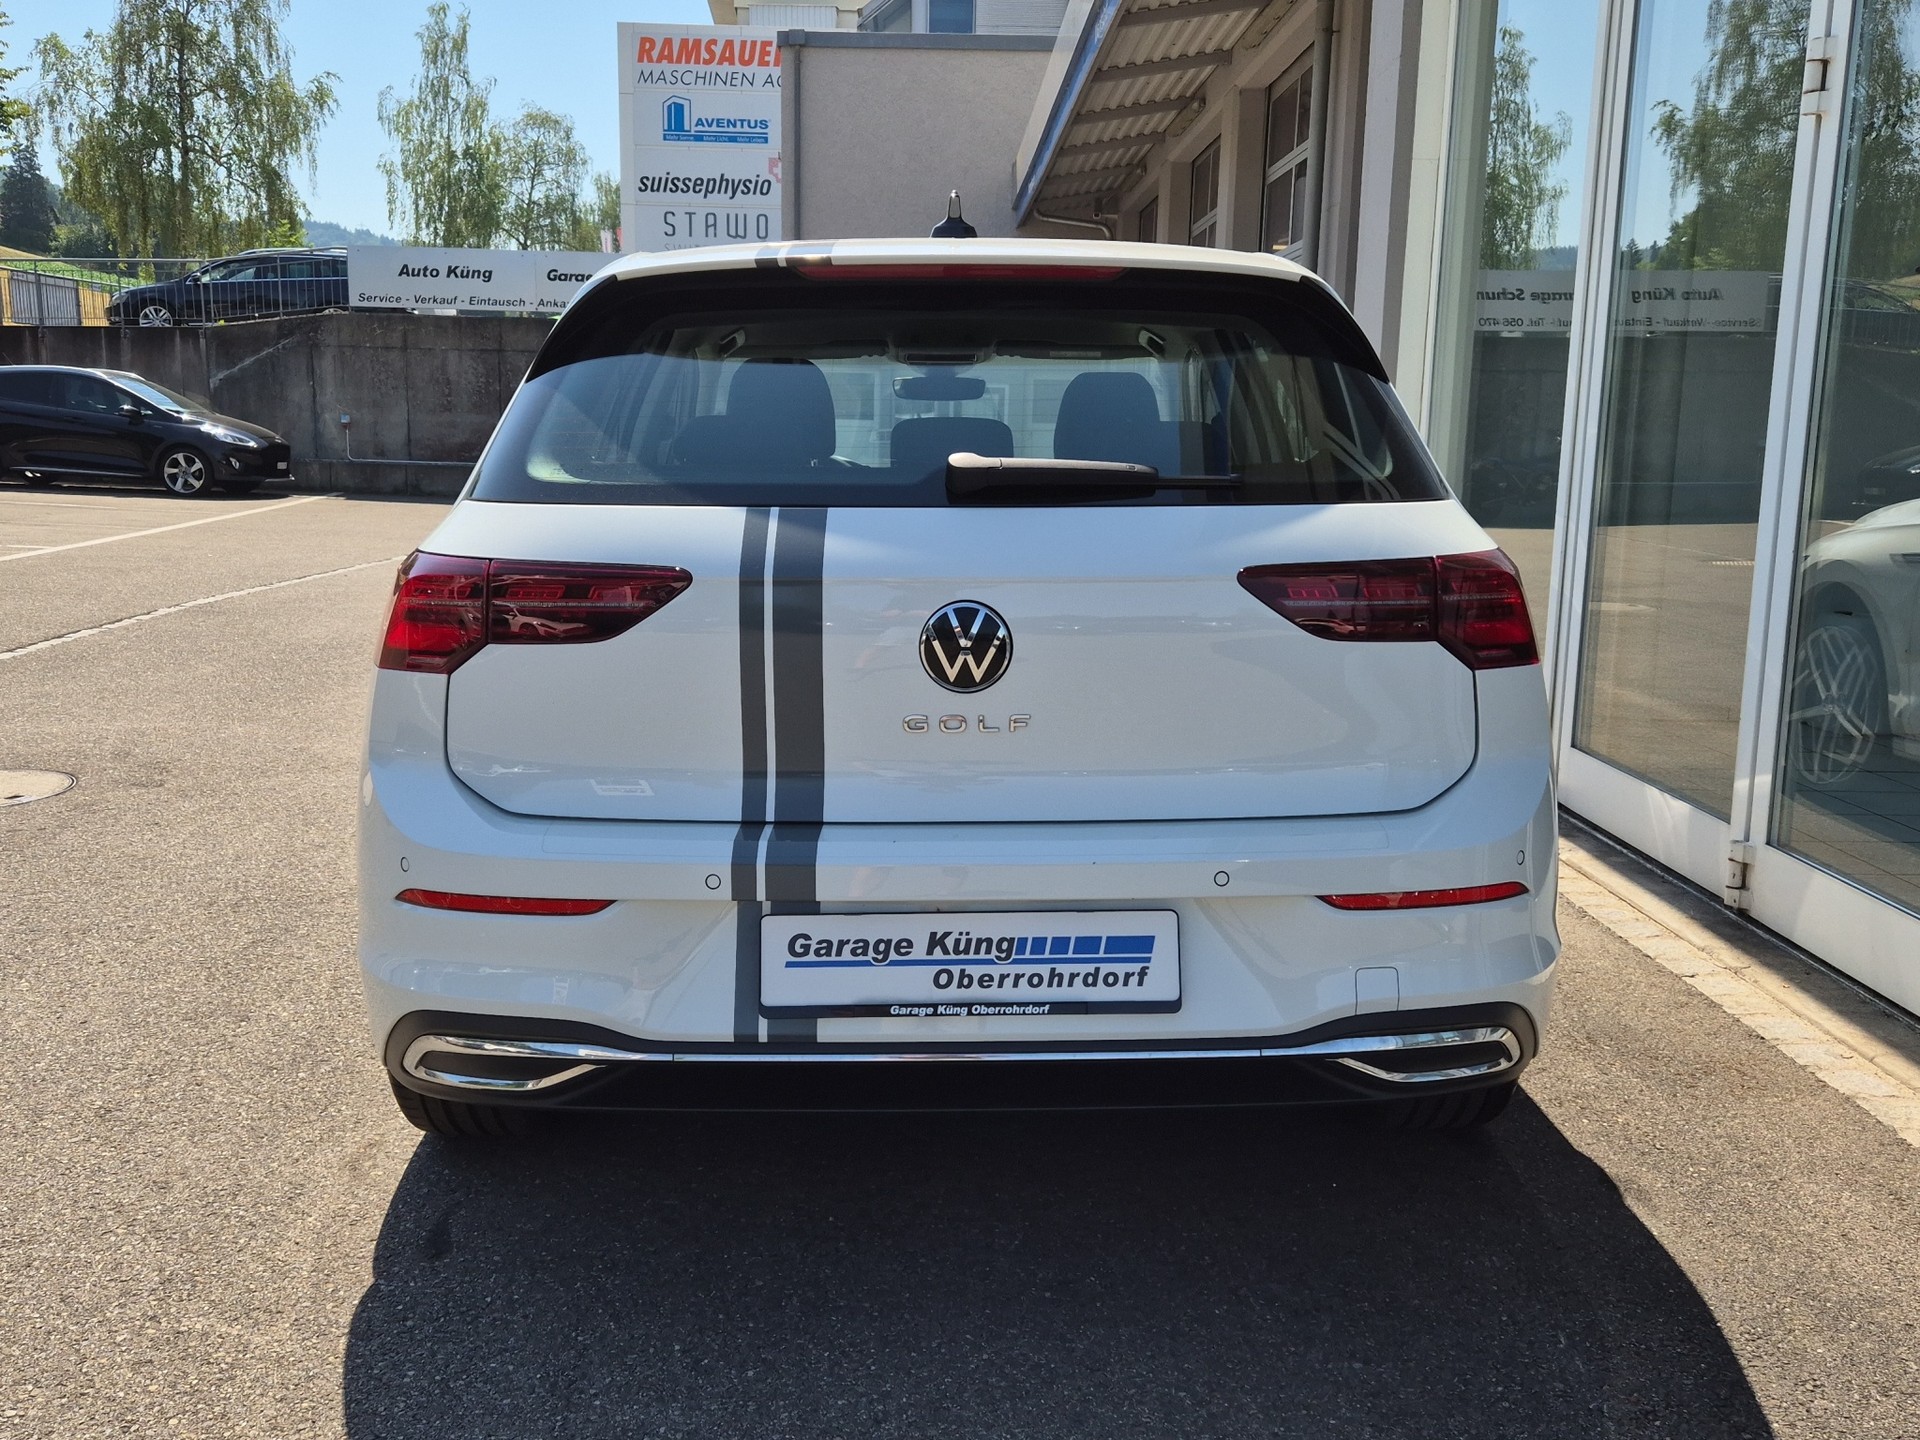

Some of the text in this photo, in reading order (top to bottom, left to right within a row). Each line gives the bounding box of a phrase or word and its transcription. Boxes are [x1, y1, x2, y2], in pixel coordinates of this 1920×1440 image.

[637, 69, 756, 88] MASCHINEN
[694, 117, 769, 130] AVENTUS
[637, 171, 772, 200] suissephysio
[664, 210, 769, 240] STAWO
[398, 263, 493, 283] Auto Küng
[358, 292, 402, 304] Service
[413, 294, 458, 305] Verkauf
[469, 296, 526, 308] Eintausch
[537, 298, 570, 309] Anka
[902, 713, 1032, 734] GOLF
[787, 930, 1017, 964] Garage Küng
[932, 965, 1150, 990] Oberrohrdorf
[890, 1004, 1050, 1017] Garage Küng Oberrohrdorf
